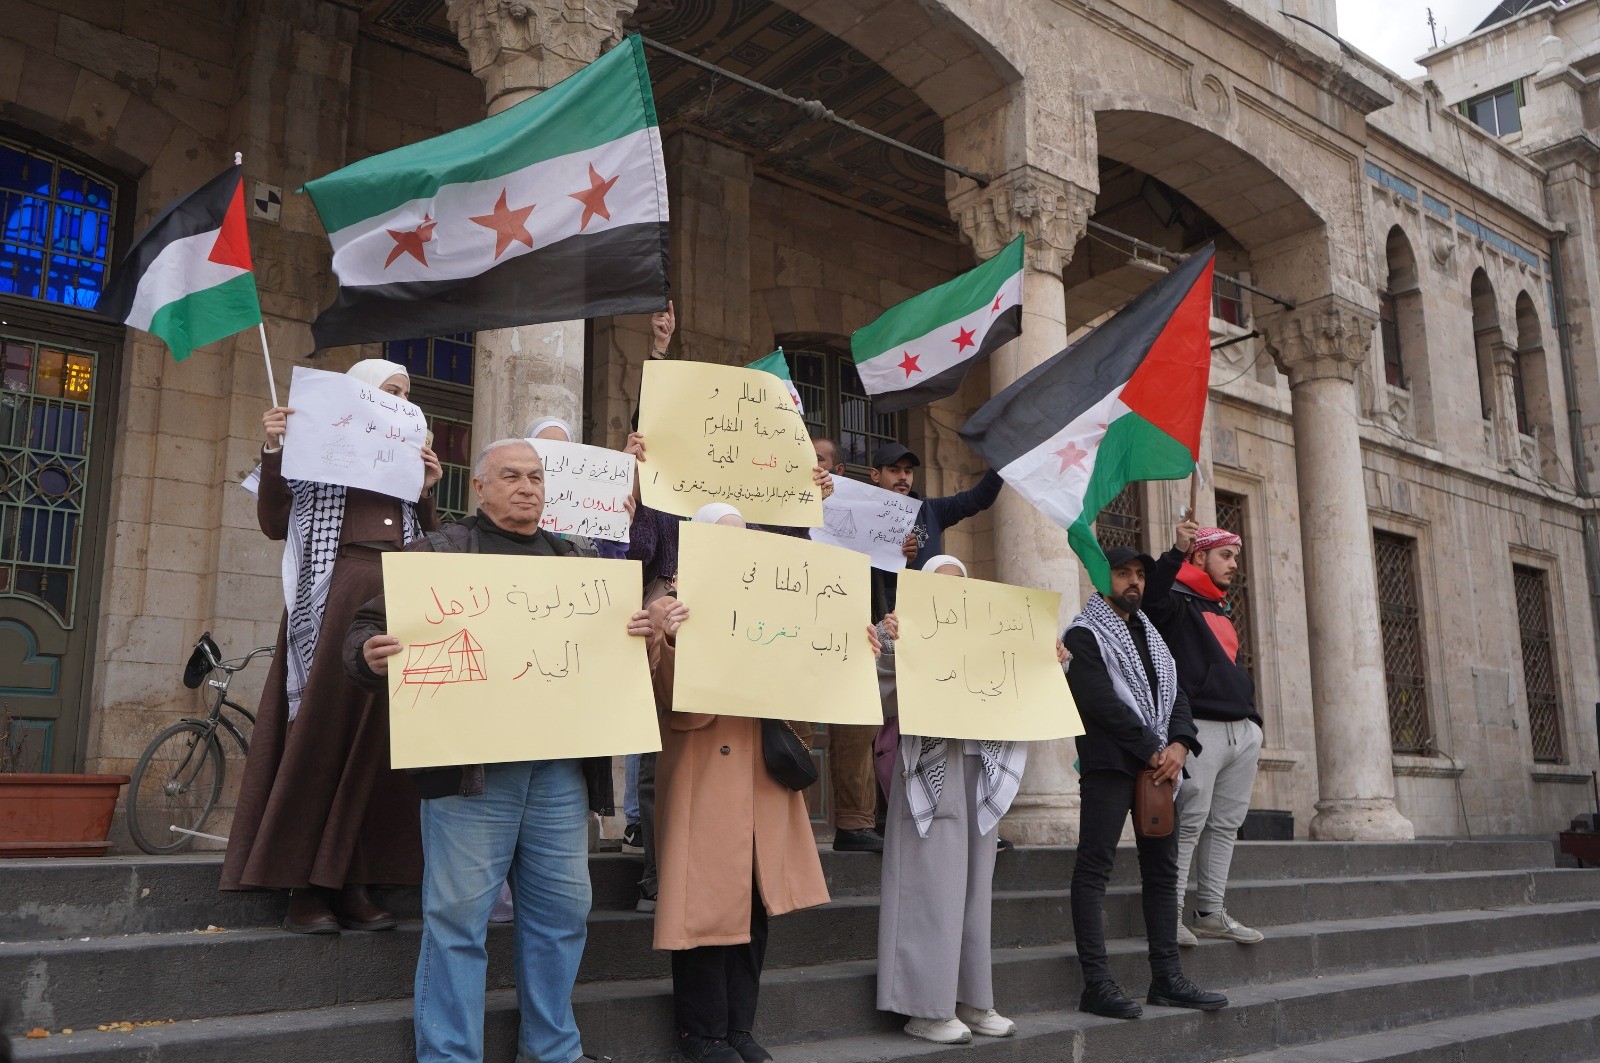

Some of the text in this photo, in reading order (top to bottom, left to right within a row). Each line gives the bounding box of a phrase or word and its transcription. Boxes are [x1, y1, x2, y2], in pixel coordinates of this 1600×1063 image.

[709, 387, 720, 400] و
[736, 381, 767, 414] العالم
[703, 413, 743, 438] المظلوم
[539, 455, 630, 484] أهل غزة في الخيا
[706, 443, 740, 470] الخيمة
[751, 452, 778, 471] قلب
[424, 579, 611, 625] الأولوية لأهل
[741, 560, 848, 622] خيم أهلنا في
[920, 589, 1036, 641] أنقذوا أهل
[731, 610, 849, 662] إدلب تغرق !
[512, 640, 581, 683] الخيام
[935, 650, 1019, 702] الخيام
